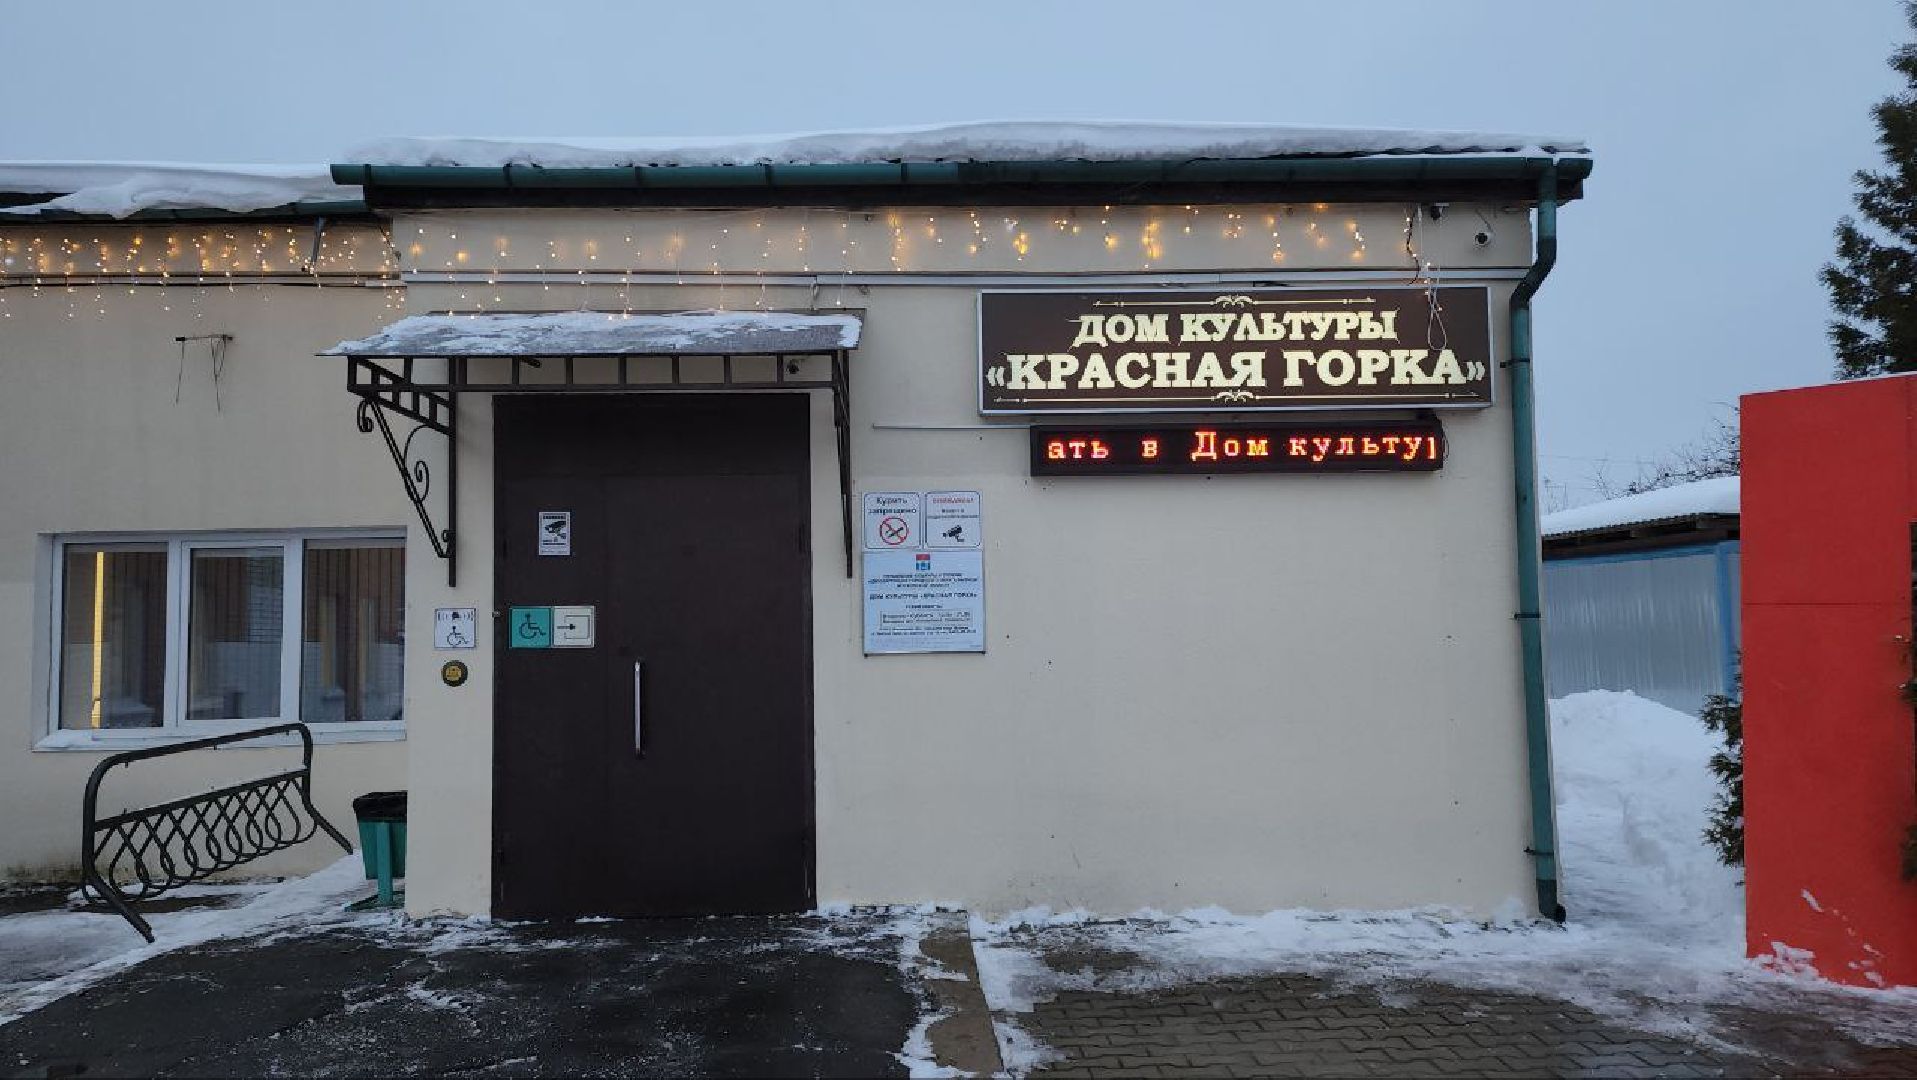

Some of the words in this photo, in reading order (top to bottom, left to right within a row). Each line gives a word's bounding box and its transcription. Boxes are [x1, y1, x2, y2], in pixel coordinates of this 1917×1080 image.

[1071, 314, 1170, 348] ДОМ
[1178, 311, 1399, 342] КУЛЬТУРЫ
[986, 351, 1266, 390] «КРАСНАЯ
[1282, 349, 1486, 387] ГОРКА»
[1048, 440, 1109, 459] ать
[1141, 440, 1158, 457] в
[1191, 431, 1268, 461] Дом
